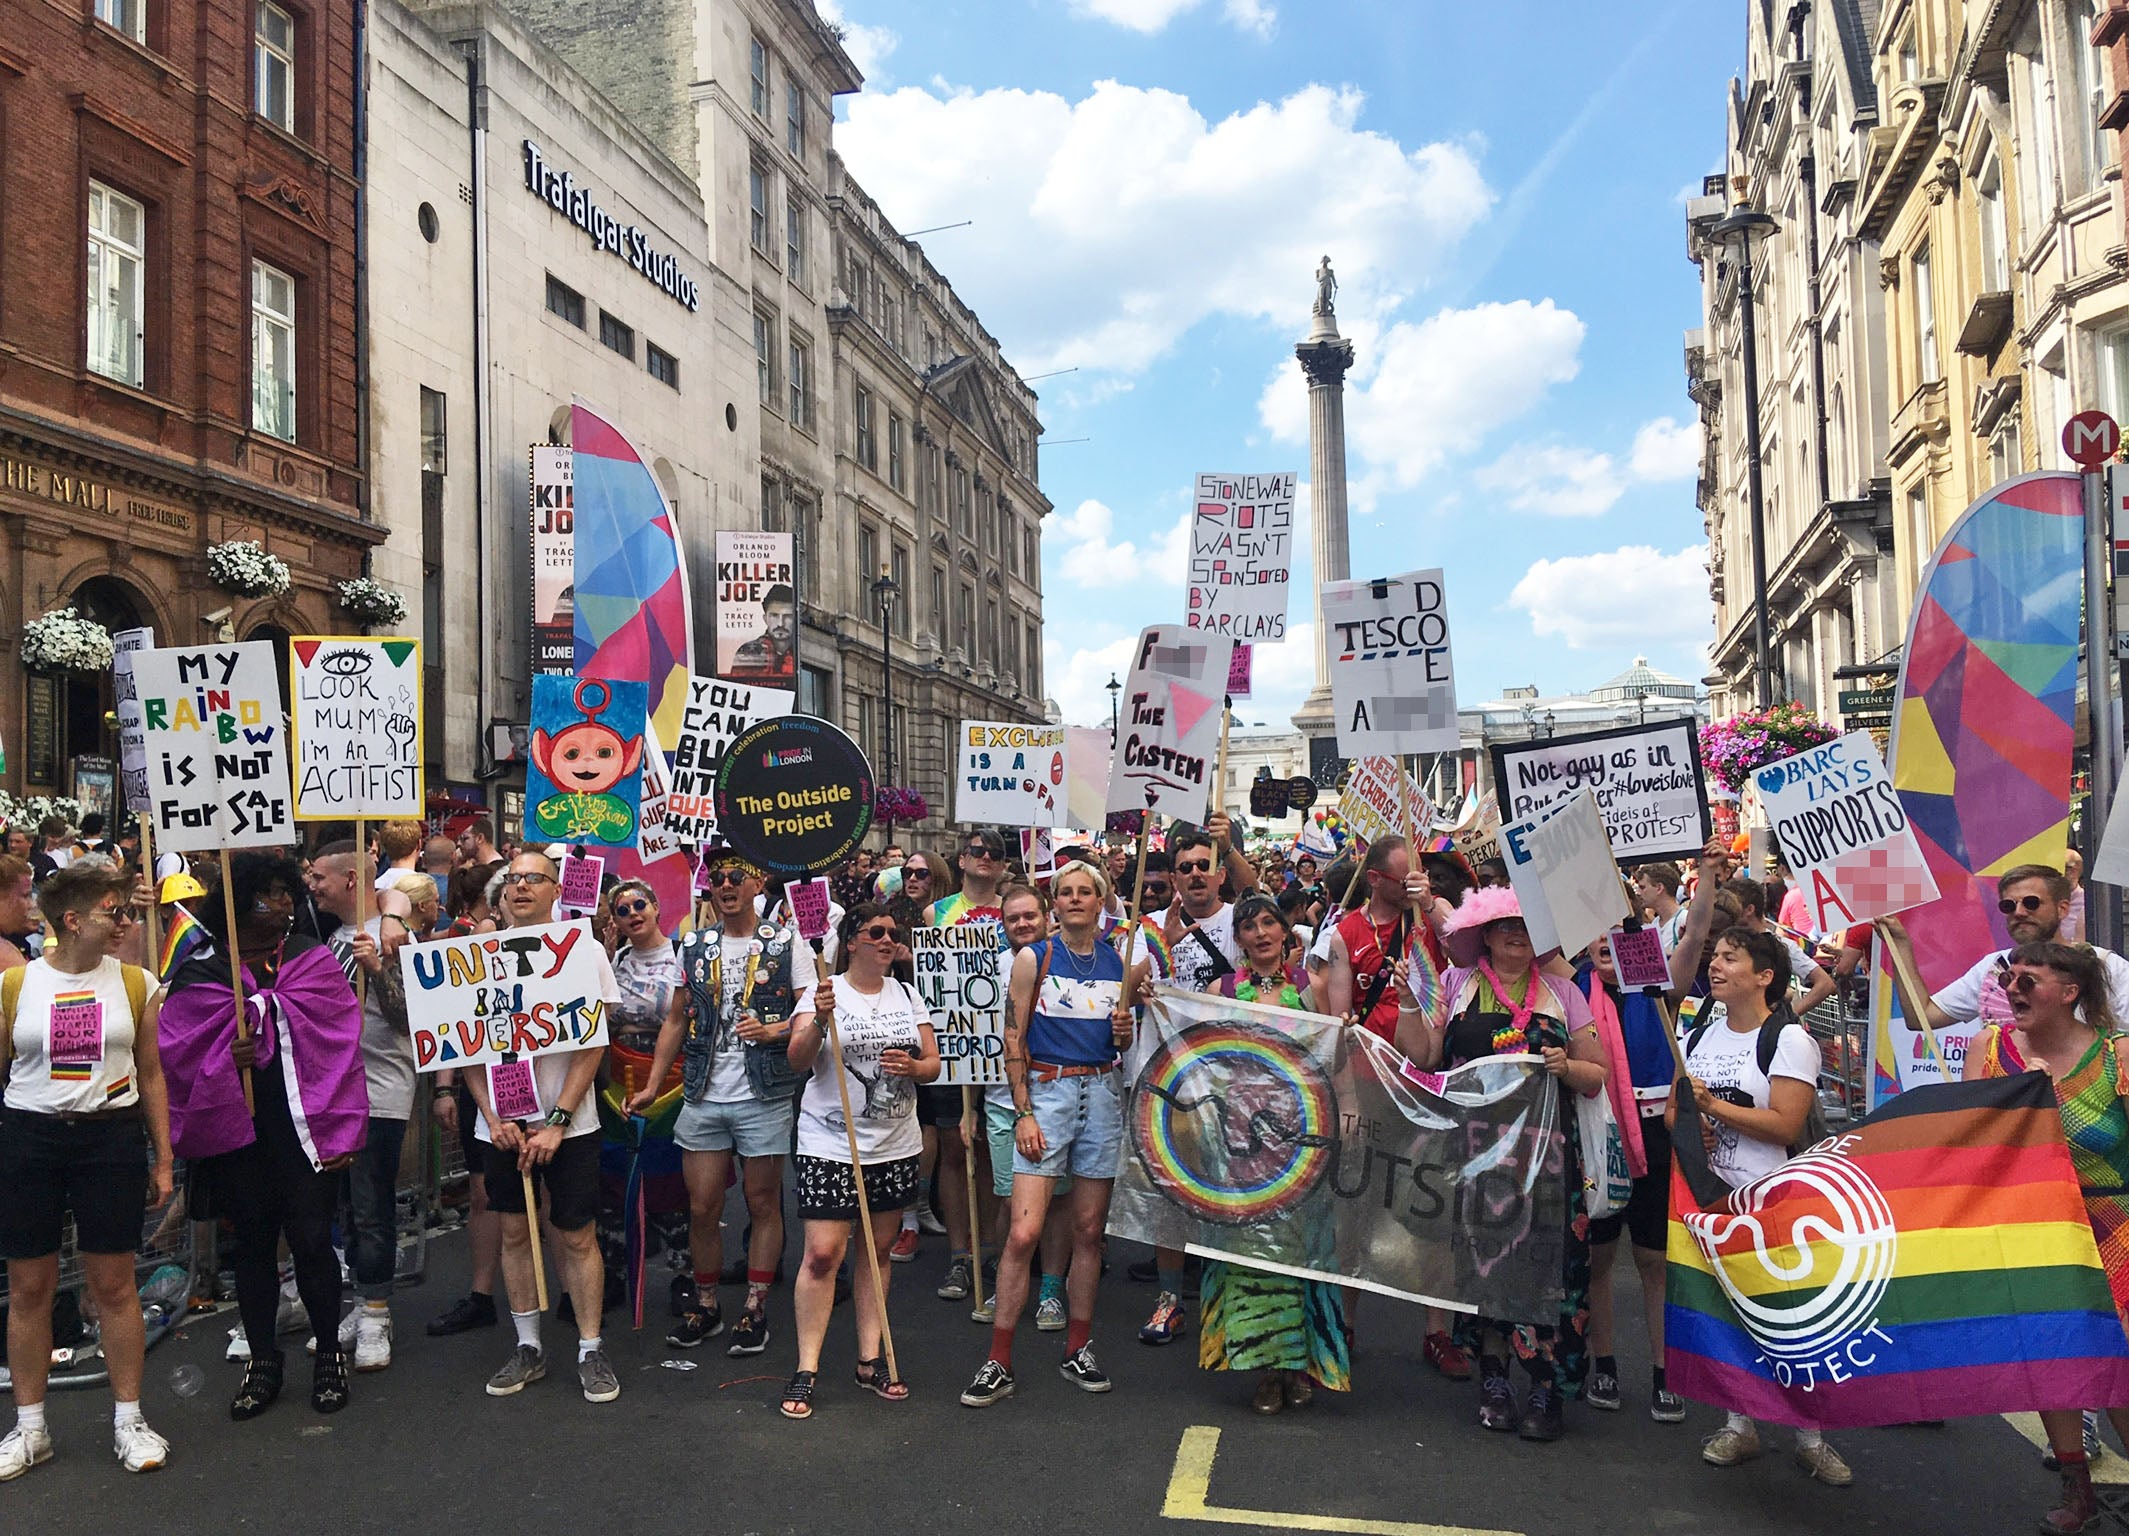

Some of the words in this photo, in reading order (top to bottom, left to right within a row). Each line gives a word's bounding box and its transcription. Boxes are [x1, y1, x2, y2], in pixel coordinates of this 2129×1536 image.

[524, 139, 630, 263] Trafalgar
[628, 225, 700, 313] Studios
[2073, 420, 2110, 454] M
[0, 458, 40, 493] HE
[51, 473, 119, 516] MALL
[128, 500, 155, 521] FREE
[157, 508, 191, 531] HOUSE
[538, 510, 574, 534] JO
[545, 548, 574, 556] TRAC
[733, 543, 776, 551] ORLANDO
[1194, 530, 1288, 558] WASN'T
[546, 558, 573, 567] LETT
[718, 562, 791, 582] KILLER
[720, 583, 762, 602] JOE
[1189, 587, 1218, 610] BY
[725, 621, 753, 629] LETTS
[1187, 613, 1285, 640] BARCLAYS
[1334, 613, 1447, 651] TESCO
[177, 651, 239, 685] MY
[301, 675, 380, 701] LOOK
[691, 681, 751, 711] YOU
[1847, 696, 1884, 706] GREENE
[122, 717, 139, 728] CRAP
[315, 707, 377, 735] MUM
[1849, 718, 1880, 727] SILVER
[675, 734, 725, 771] BU
[719, 754, 736, 790] PROTEST
[734, 723, 779, 755] celebration
[781, 720, 820, 734] freedom
[779, 752, 813, 766] LONDON
[970, 752, 991, 770] IS
[1012, 752, 1025, 770] A
[1785, 743, 1846, 785] BARC
[216, 750, 273, 782] NOT
[1517, 759, 1563, 789] Not
[1566, 753, 1606, 790] gay
[1611, 747, 1637, 769] as
[1647, 744, 1676, 767] in
[672, 769, 716, 796] INT
[967, 775, 1017, 792] TURN
[1613, 763, 1695, 798] #loveislove
[1806, 759, 1872, 802] LAYS
[668, 793, 717, 819] QUE
[736, 795, 774, 815] The
[776, 784, 852, 810] Outside
[1351, 767, 1364, 789] I
[1360, 774, 1398, 823] CHOOSE
[228, 790, 285, 836] SALE
[664, 812, 715, 839] HAPP
[762, 810, 834, 837] Project
[1777, 780, 1905, 869] SUPPORTS
[1605, 814, 1691, 846] PROTEST
[1462, 838, 1497, 865] OPERTY
[565, 880, 595, 889] OUR
[799, 908, 825, 918] OUR
[916, 951, 948, 973] FOR
[952, 950, 1001, 977] THOSE
[1172, 946, 1194, 955] UIET
[1178, 955, 1200, 963] WILL
[1623, 955, 1659, 966] OUR
[1186, 961, 1198, 972] UP
[1199, 968, 1214, 979] SHI
[722, 977, 740, 985] ILL
[917, 974, 998, 1010] WHO
[474, 983, 523, 1017] IN
[54, 1029, 96, 1039] OUR
[850, 1033, 857, 1042] I
[861, 1031, 889, 1041] WILL
[892, 1027, 911, 1037] NOT
[928, 1009, 1000, 1034] CAN'T
[843, 1043, 867, 1054] PUT
[872, 1041, 887, 1051] UP
[891, 1037, 918, 1049] WITH
[936, 1034, 1004, 1060] FFORD
[1944, 1035, 1973, 1049] PRI
[857, 1053, 879, 1064] THI
[939, 1056, 961, 1082] T
[1691, 1070, 1712, 1078] ILL
[1717, 1069, 1740, 1077] NOT
[498, 1086, 529, 1098] OUR
[1342, 1113, 1382, 1142] THE
[1755, 1317, 1894, 1393] OJECT
